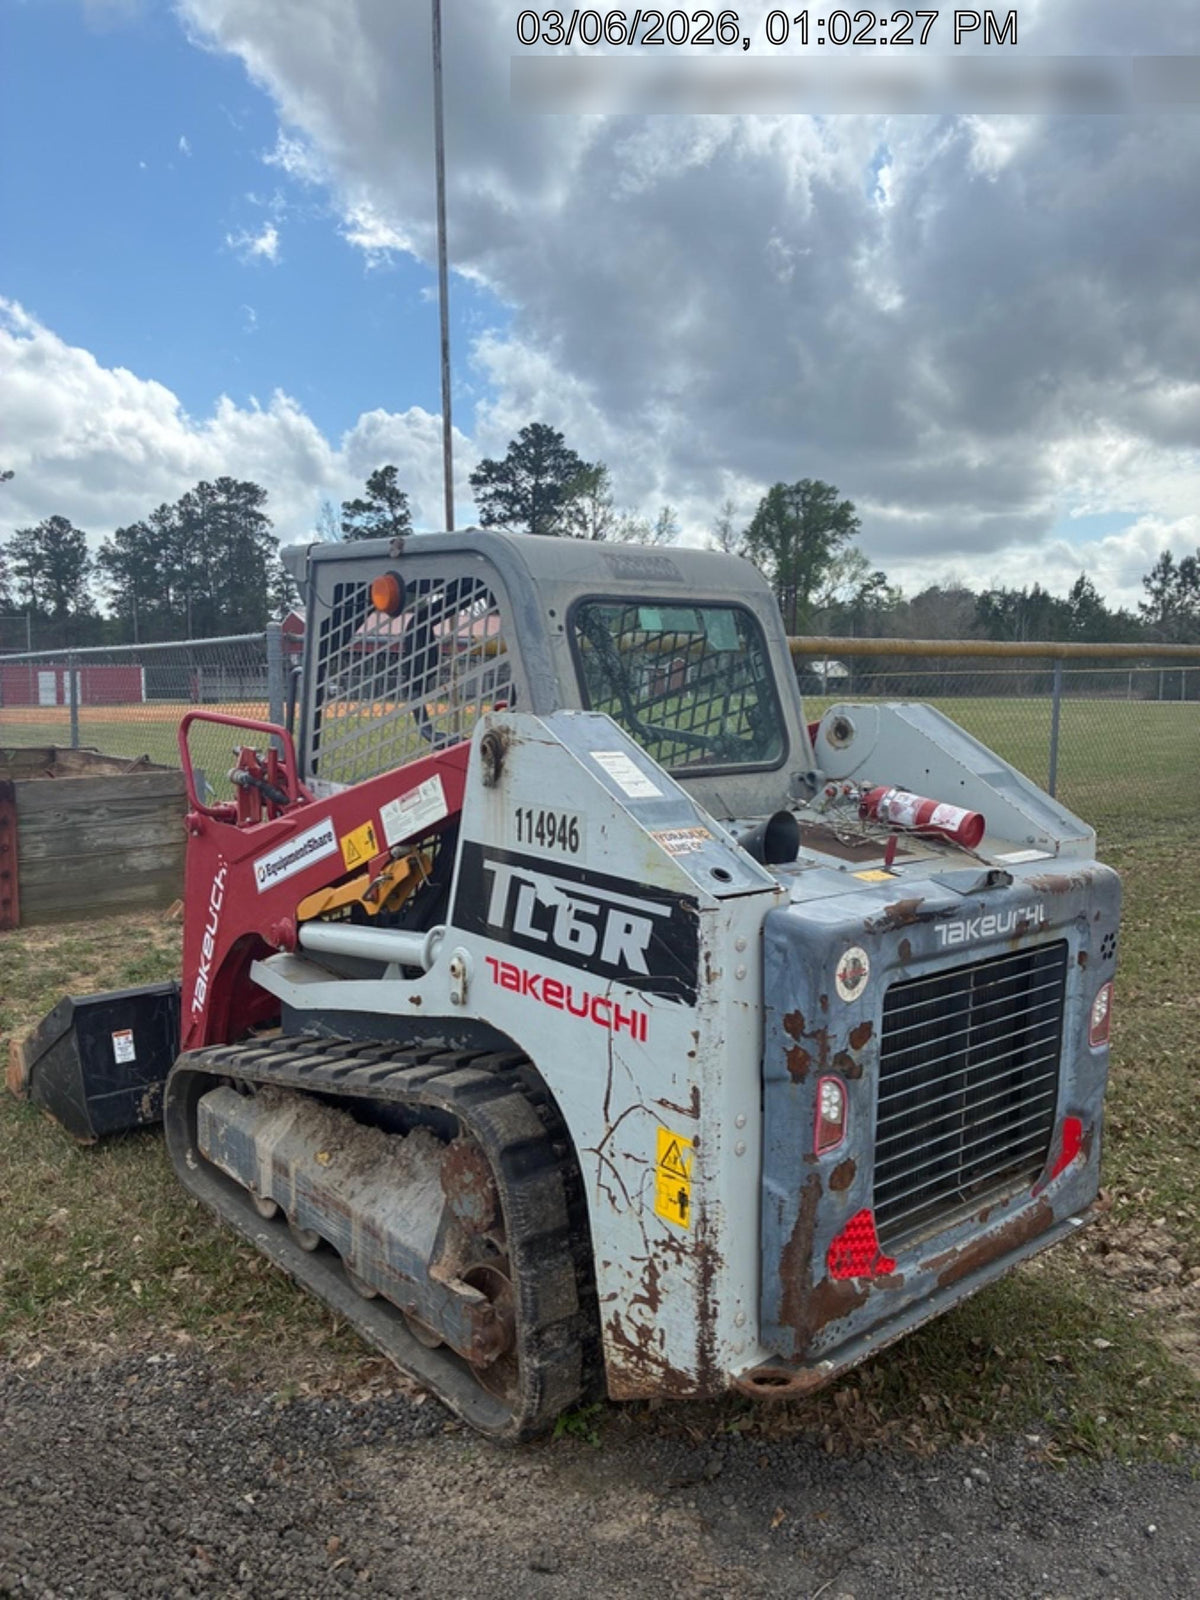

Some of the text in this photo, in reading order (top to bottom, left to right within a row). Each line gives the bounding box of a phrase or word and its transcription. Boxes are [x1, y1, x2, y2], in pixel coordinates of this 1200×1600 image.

[265, 831, 333, 877] EquipmentShare
[514, 806, 580, 854] 114946
[483, 859, 672, 977] TL6R
